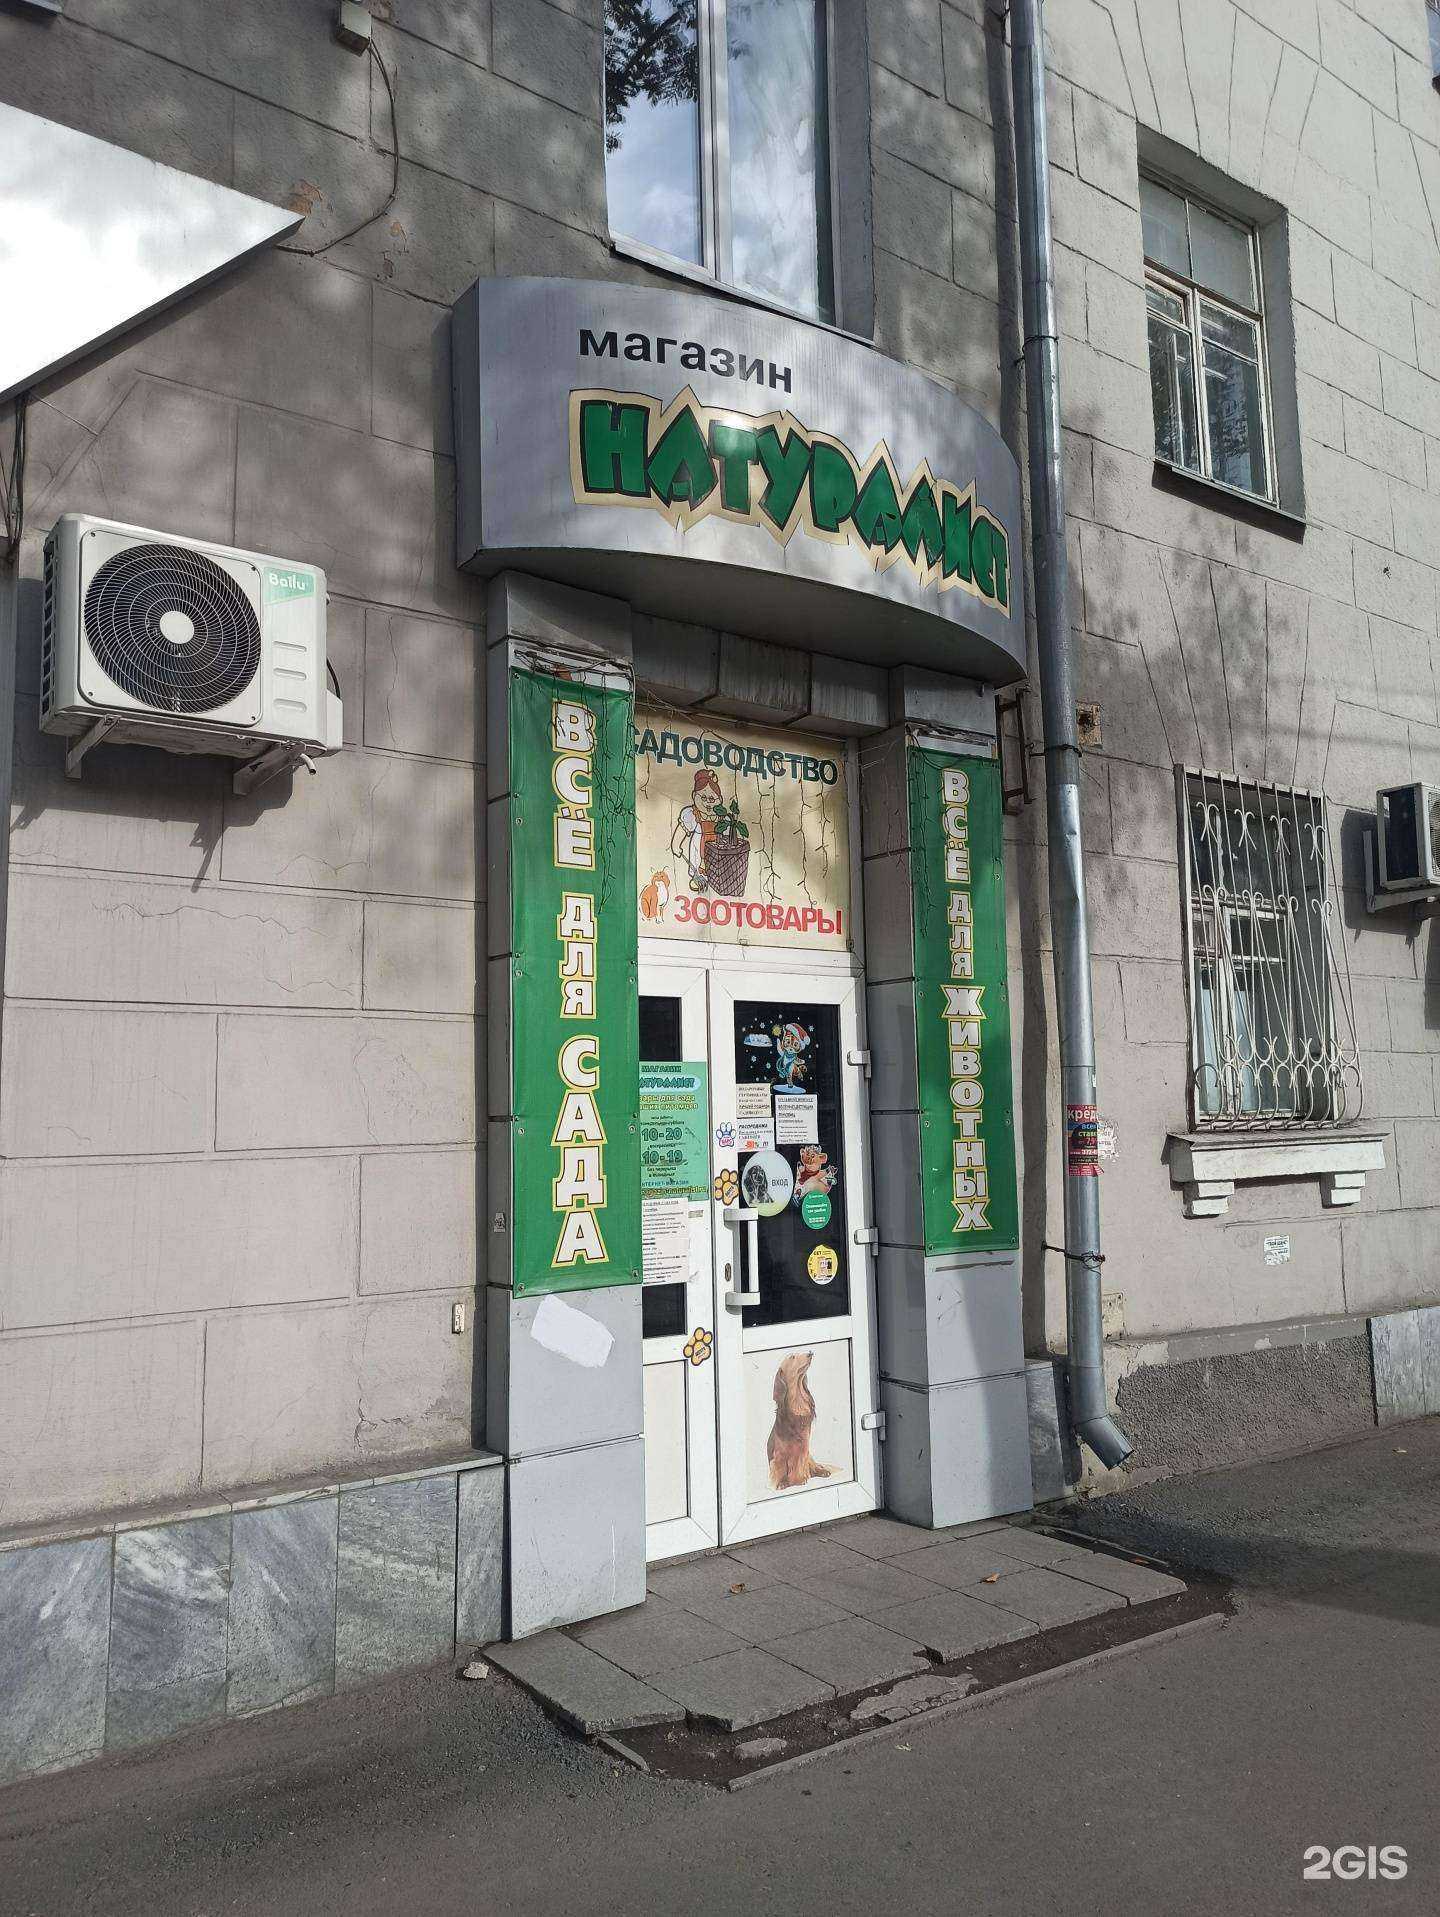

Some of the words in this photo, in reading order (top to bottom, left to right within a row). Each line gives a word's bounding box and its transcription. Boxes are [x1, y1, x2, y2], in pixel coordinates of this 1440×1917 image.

[578, 328, 793, 394] магазин
[572, 389, 1010, 614] НАТУРАЛИСТ
[269, 572, 306, 591] Ballu
[552, 700, 597, 871] ВСЁ
[634, 728, 838, 786] АДОВОДСТВО
[942, 768, 970, 884] ВСЁ
[557, 892, 599, 1019] ДЛЯ
[674, 895, 842, 935] ЗООТОВАРЫ
[948, 891, 974, 978] ДЛЯ
[551, 1034, 609, 1267] САДА
[941, 985, 993, 1232] ЖИВОТНЫХ
[771, 1178, 789, 1188] ВХОД
